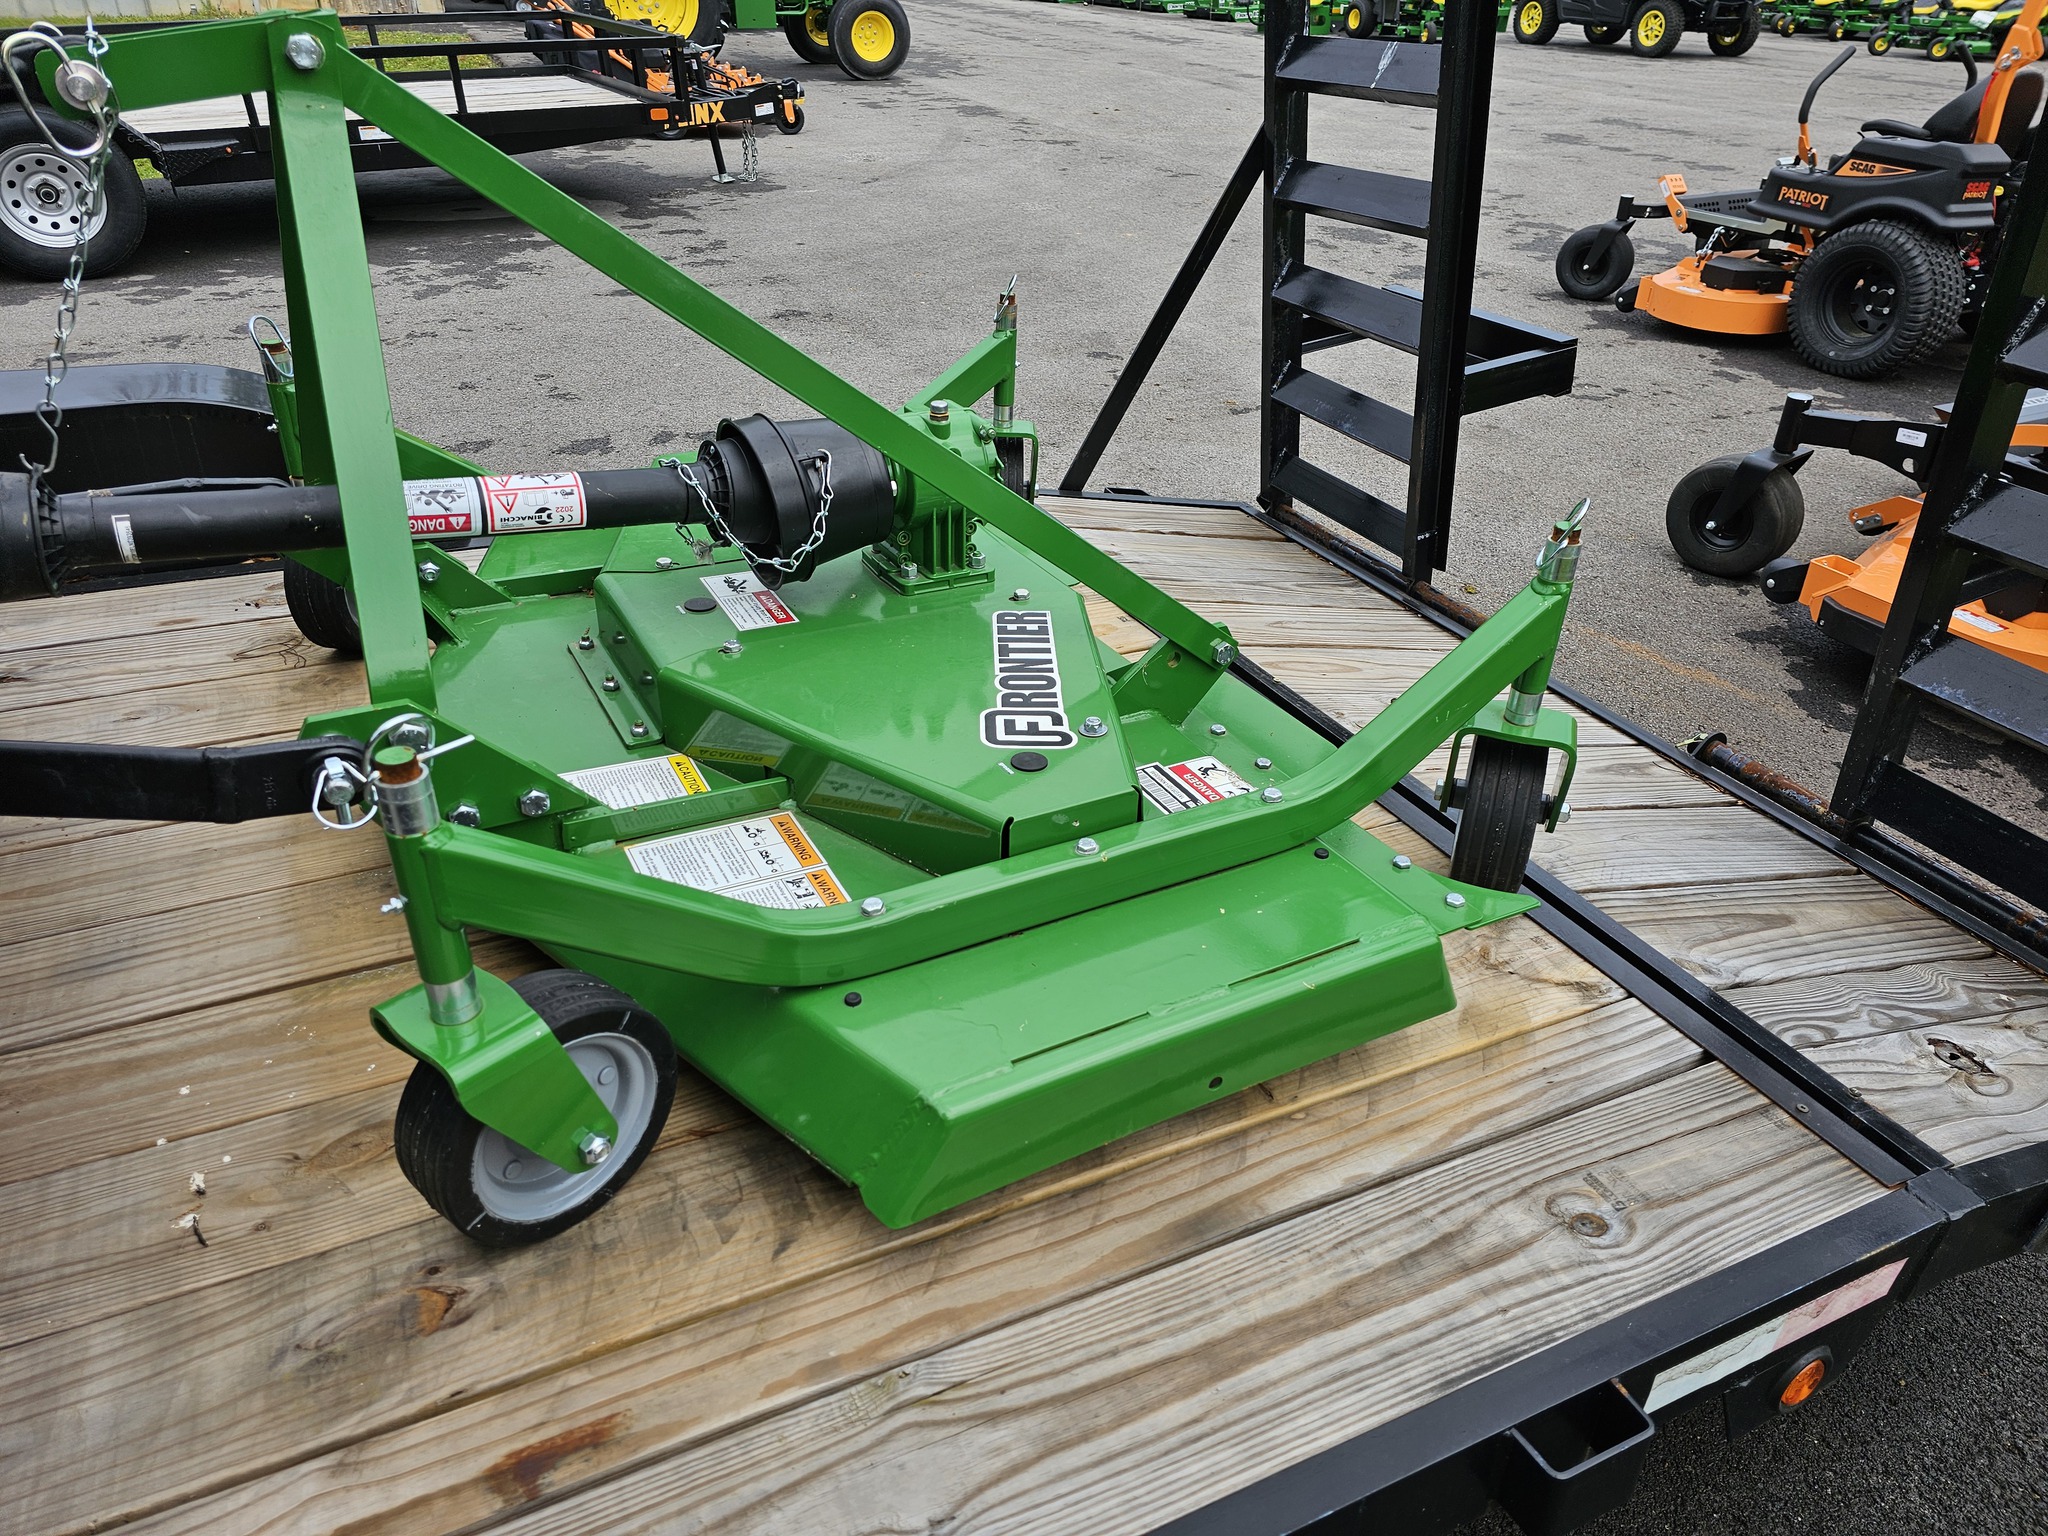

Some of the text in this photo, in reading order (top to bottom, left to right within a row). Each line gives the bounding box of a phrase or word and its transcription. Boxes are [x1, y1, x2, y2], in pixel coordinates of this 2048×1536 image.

[1849, 161, 1876, 174] SCAG
[1962, 191, 1988, 200] PATRIOT
[1966, 181, 1991, 192] SCAG
[1777, 186, 1829, 211] PATRIOT
[500, 514, 543, 523] BINACCHI
[555, 505, 573, 513] 2022
[763, 598, 787, 619] DANGER
[984, 612, 1073, 746] FRONTIER
[679, 764, 703, 795] CAUTION
[1184, 773, 1220, 800] DANGER
[782, 826, 811, 860] WARNING
